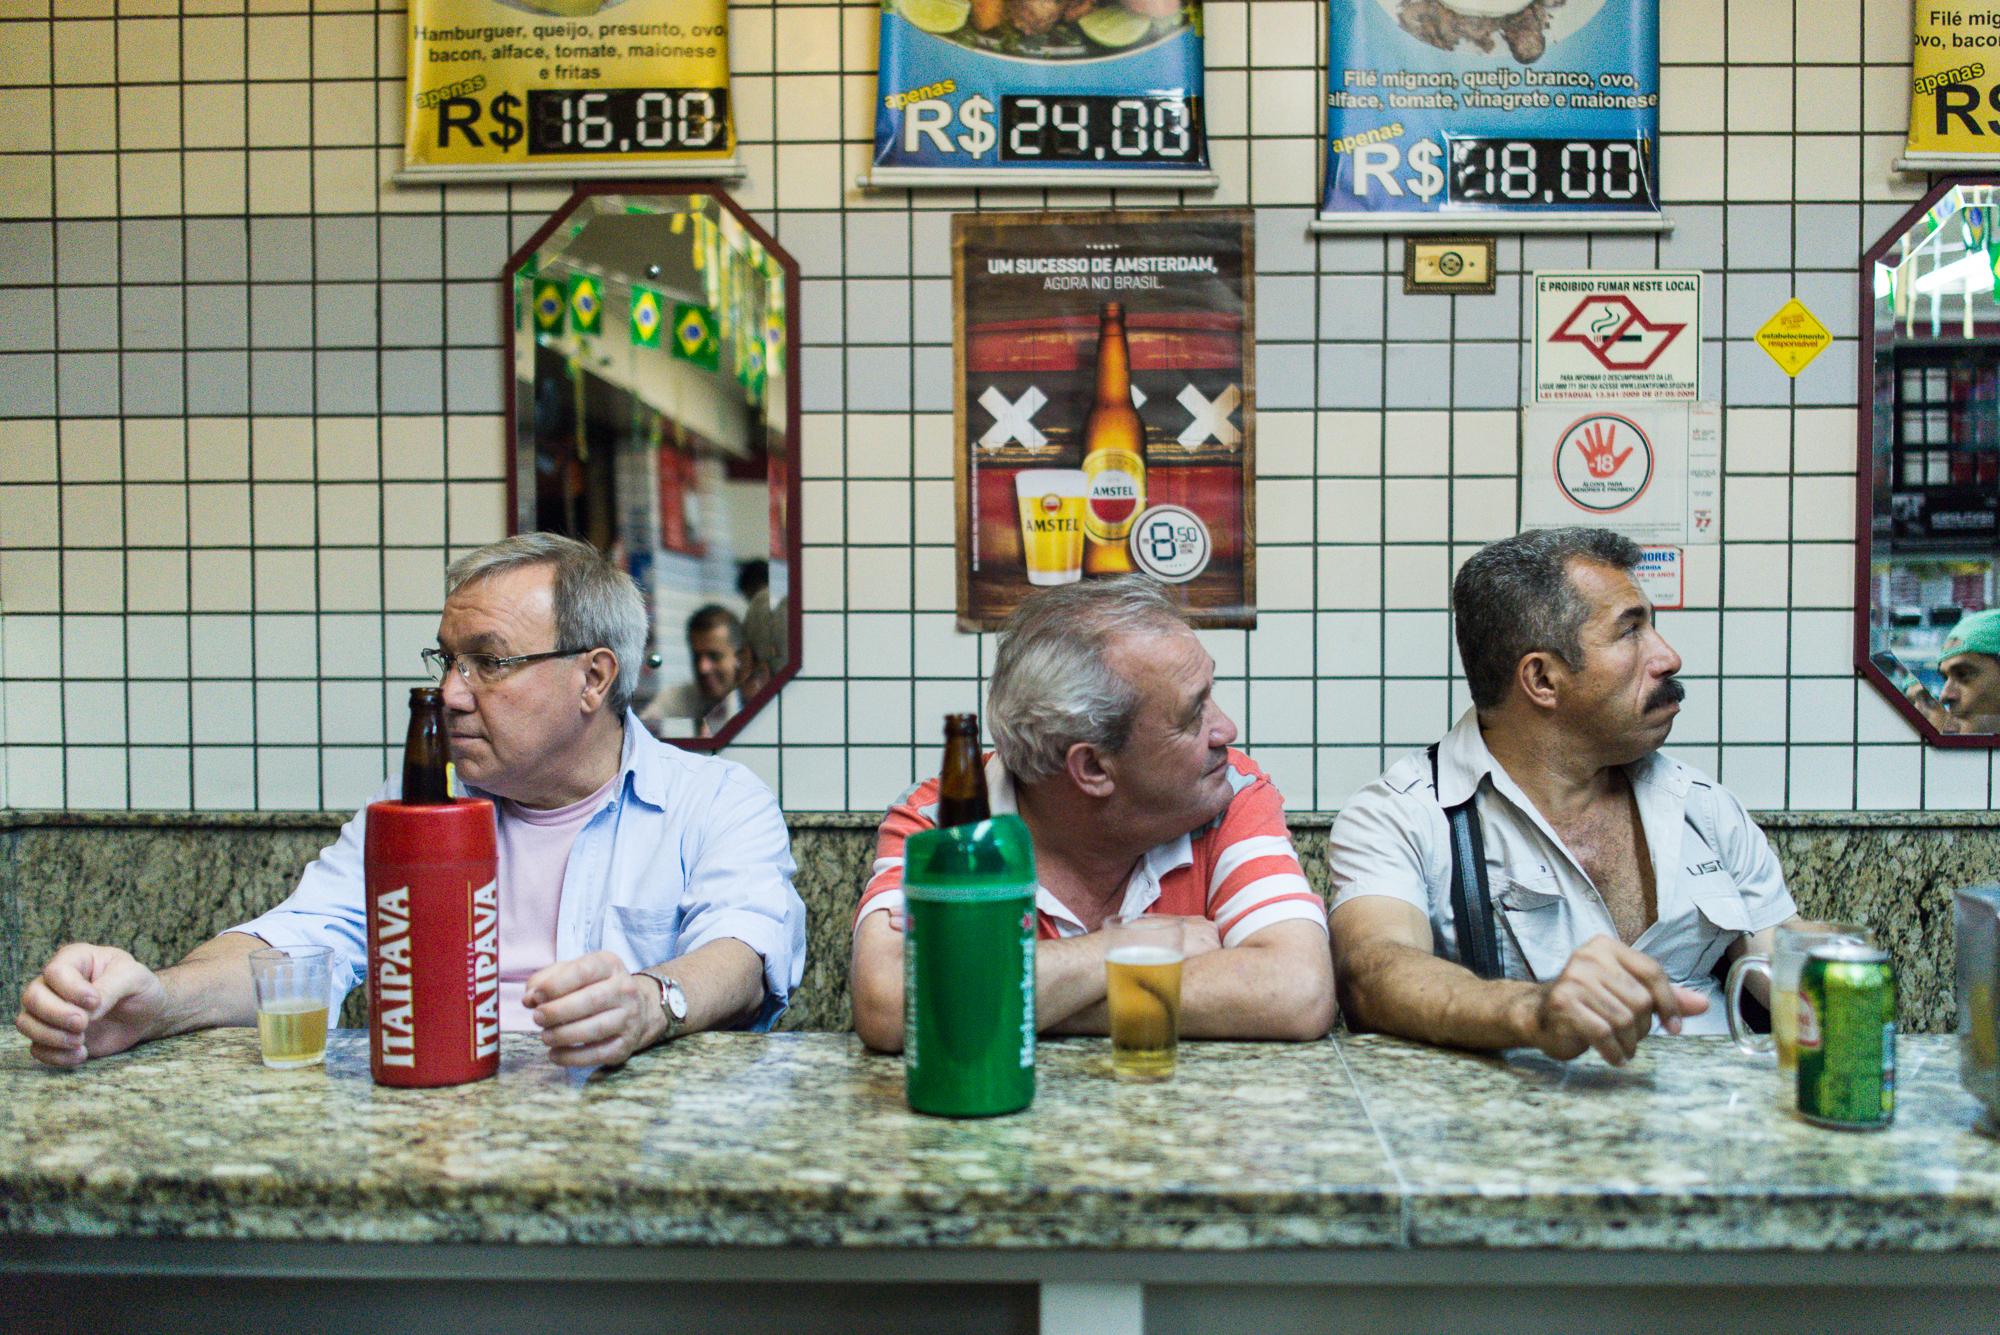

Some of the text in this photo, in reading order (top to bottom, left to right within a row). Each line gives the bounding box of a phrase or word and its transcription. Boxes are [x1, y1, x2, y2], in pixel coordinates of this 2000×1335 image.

[1931, 11, 1962, 26] Filé
[414, 26, 527, 42] Hamburguer,
[533, 22, 593, 40] queijo,
[599, 24, 685, 40] presunto,
[1953, 32, 2000, 48] baco
[428, 43, 716, 62] bacon, alface, tomate, maionese
[539, 64, 600, 79] e fritas
[1343, 70, 1639, 90] Filé mignon, queijo branco, ovo,
[1914, 62, 1985, 95] apenas
[415, 75, 487, 110] apenas
[884, 79, 957, 111] apenas
[1328, 91, 1657, 111] alface, tomate, vinagrete e maionese
[438, 91, 524, 153] R$
[905, 94, 997, 160] R$
[1332, 121, 1405, 154] apenas
[1353, 138, 1445, 204] R$
[988, 256, 1218, 274] UM SUCESSO DE AMSTERDAM,
[1043, 275, 1165, 290] AGORA NO BRASIL.
[1549, 281, 1594, 291] PROIBIDO
[1597, 281, 1630, 291] FUMAR
[1633, 281, 1663, 291] NESTE
[1666, 281, 1695, 291] LOCAL
[1554, 391, 1592, 399] ESTADUAL
[1093, 486, 1134, 496] AMSTEL
[1025, 518, 1079, 532] AMSTEL
[1642, 552, 1675, 562] NORES
[377, 886, 415, 1068] ITAIPAVA
[473, 877, 498, 1060] ITAIPAVA
